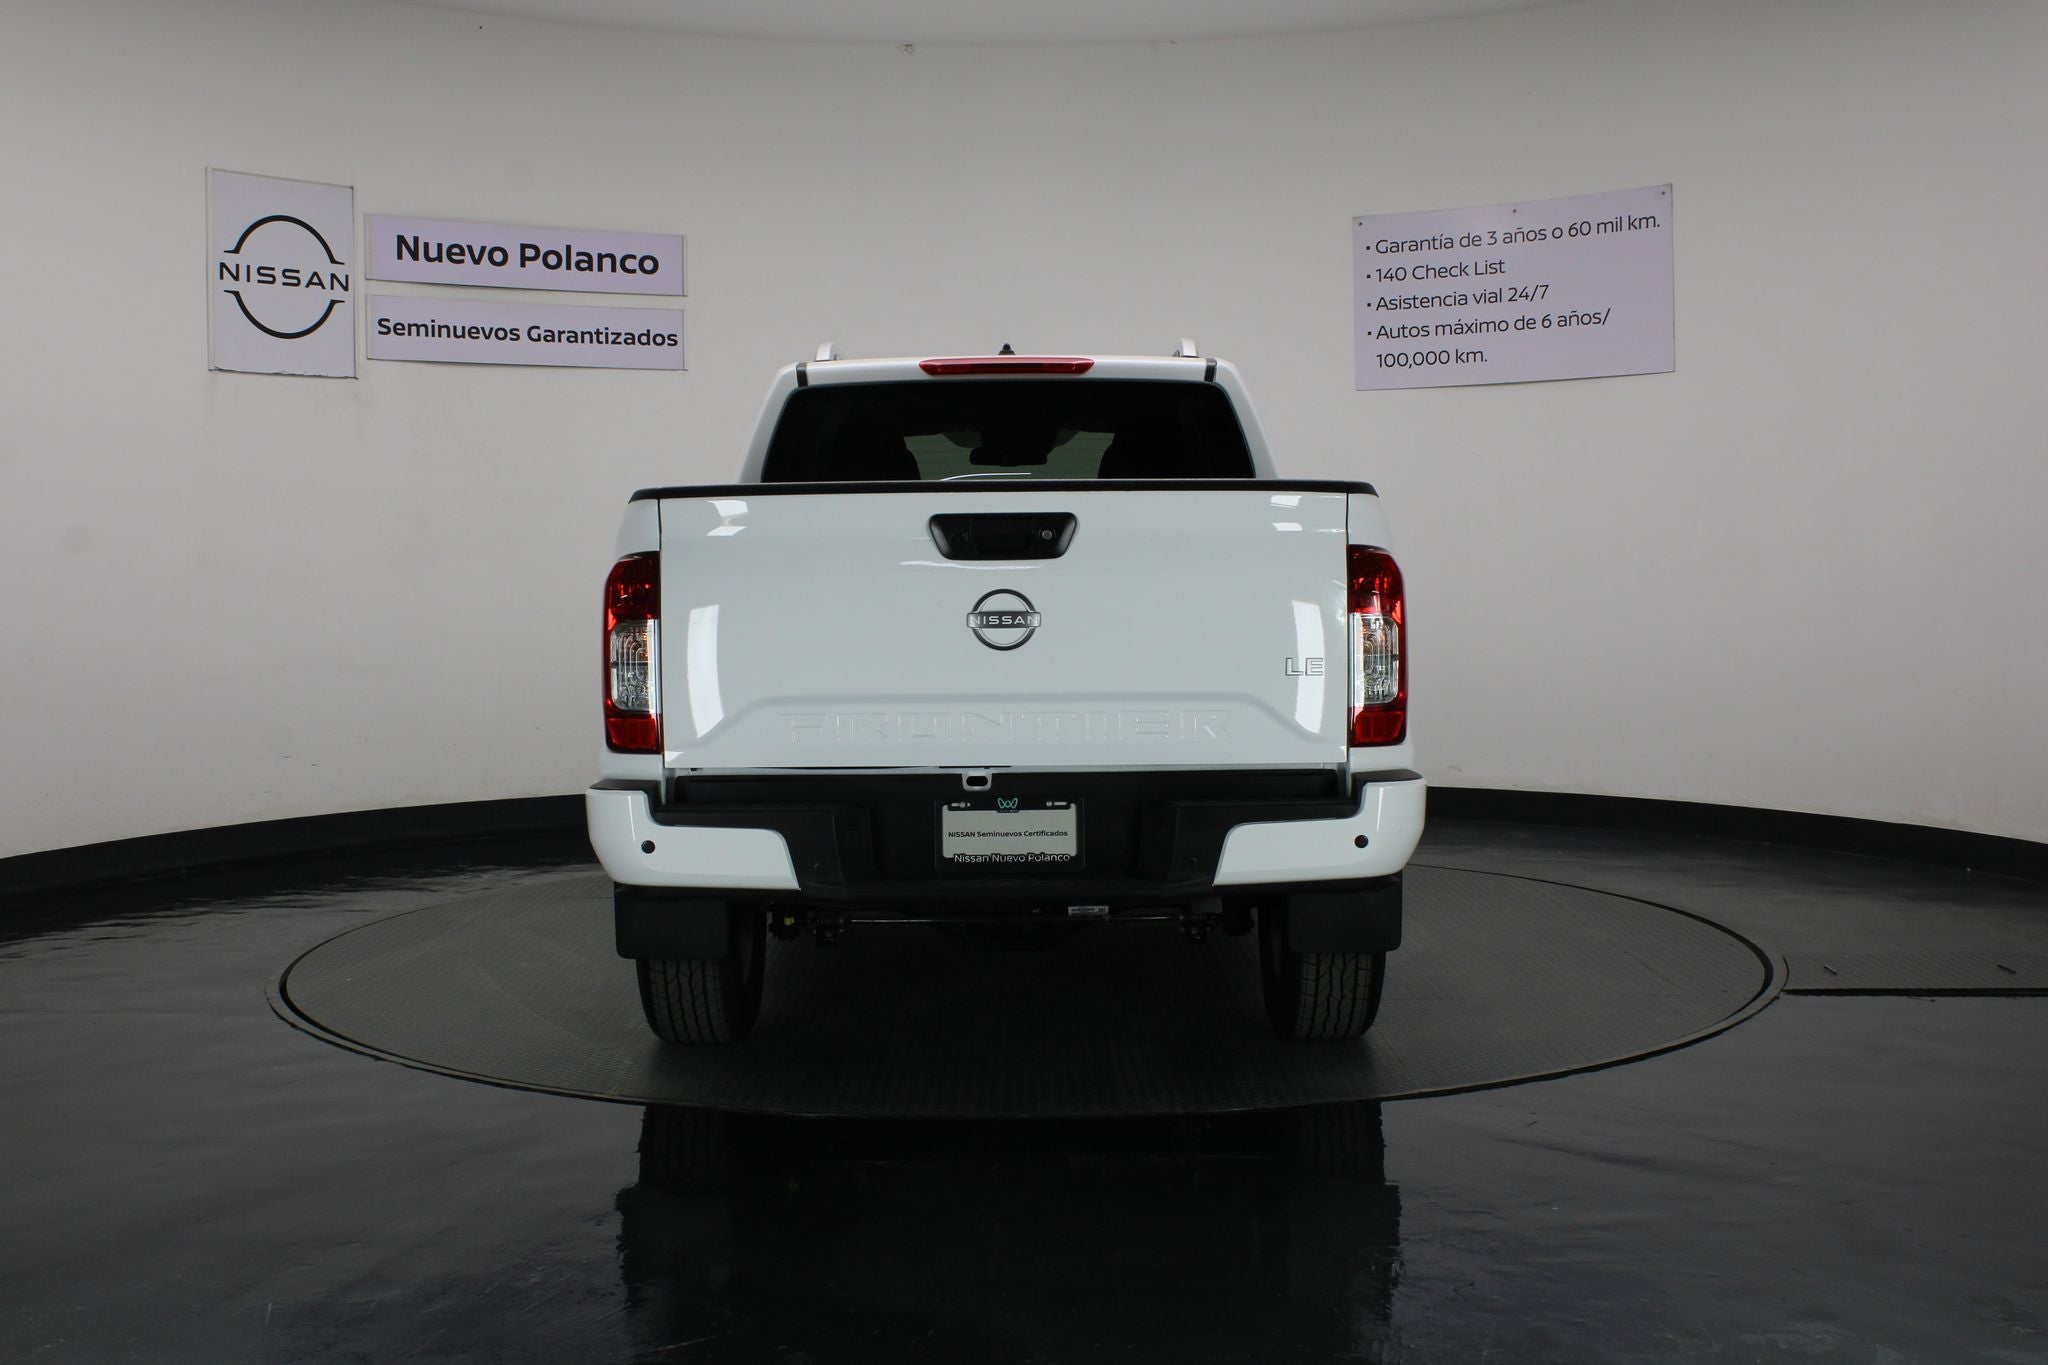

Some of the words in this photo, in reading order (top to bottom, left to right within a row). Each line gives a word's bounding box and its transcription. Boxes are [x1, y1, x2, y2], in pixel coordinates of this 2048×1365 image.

[1375, 234, 1454, 254] Garantía
[1459, 231, 1482, 248] de
[1487, 230, 1497, 246] 3
[1502, 227, 1547, 244] años
[1551, 227, 1563, 239] o
[1567, 221, 1591, 238] 60
[1596, 216, 1623, 234] mil
[1628, 214, 1661, 231] km.
[396, 234, 509, 267] Nuevo
[519, 242, 660, 275] Polanco
[219, 261, 350, 292] NISSAN
[1375, 266, 1407, 283] 140
[1412, 262, 1469, 281] Check
[1474, 259, 1506, 277] List
[1375, 291, 1469, 312] Asistencia
[1472, 287, 1503, 305] vial
[1507, 284, 1549, 302] 24/7
[376, 317, 521, 342] Seminuevos
[526, 324, 678, 348] Garantizados
[1376, 321, 1430, 340] Autos
[1435, 318, 1509, 337] máximo
[1513, 314, 1537, 331] de
[1541, 313, 1552, 329] 6
[1556, 307, 1611, 328] años/
[1376, 349, 1450, 369] 100,000
[1455, 348, 1488, 365] km.
[969, 615, 1039, 626] NISSAN
[1285, 657, 1324, 676] LE
[780, 711, 1232, 743] FRONTIER
[976, 830, 1023, 838] Seminuevos
[1023, 830, 1069, 838] Certificados
[954, 853, 989, 863] Nissan
[991, 853, 1026, 863] Nuevo
[1028, 852, 1071, 862] Polanco
